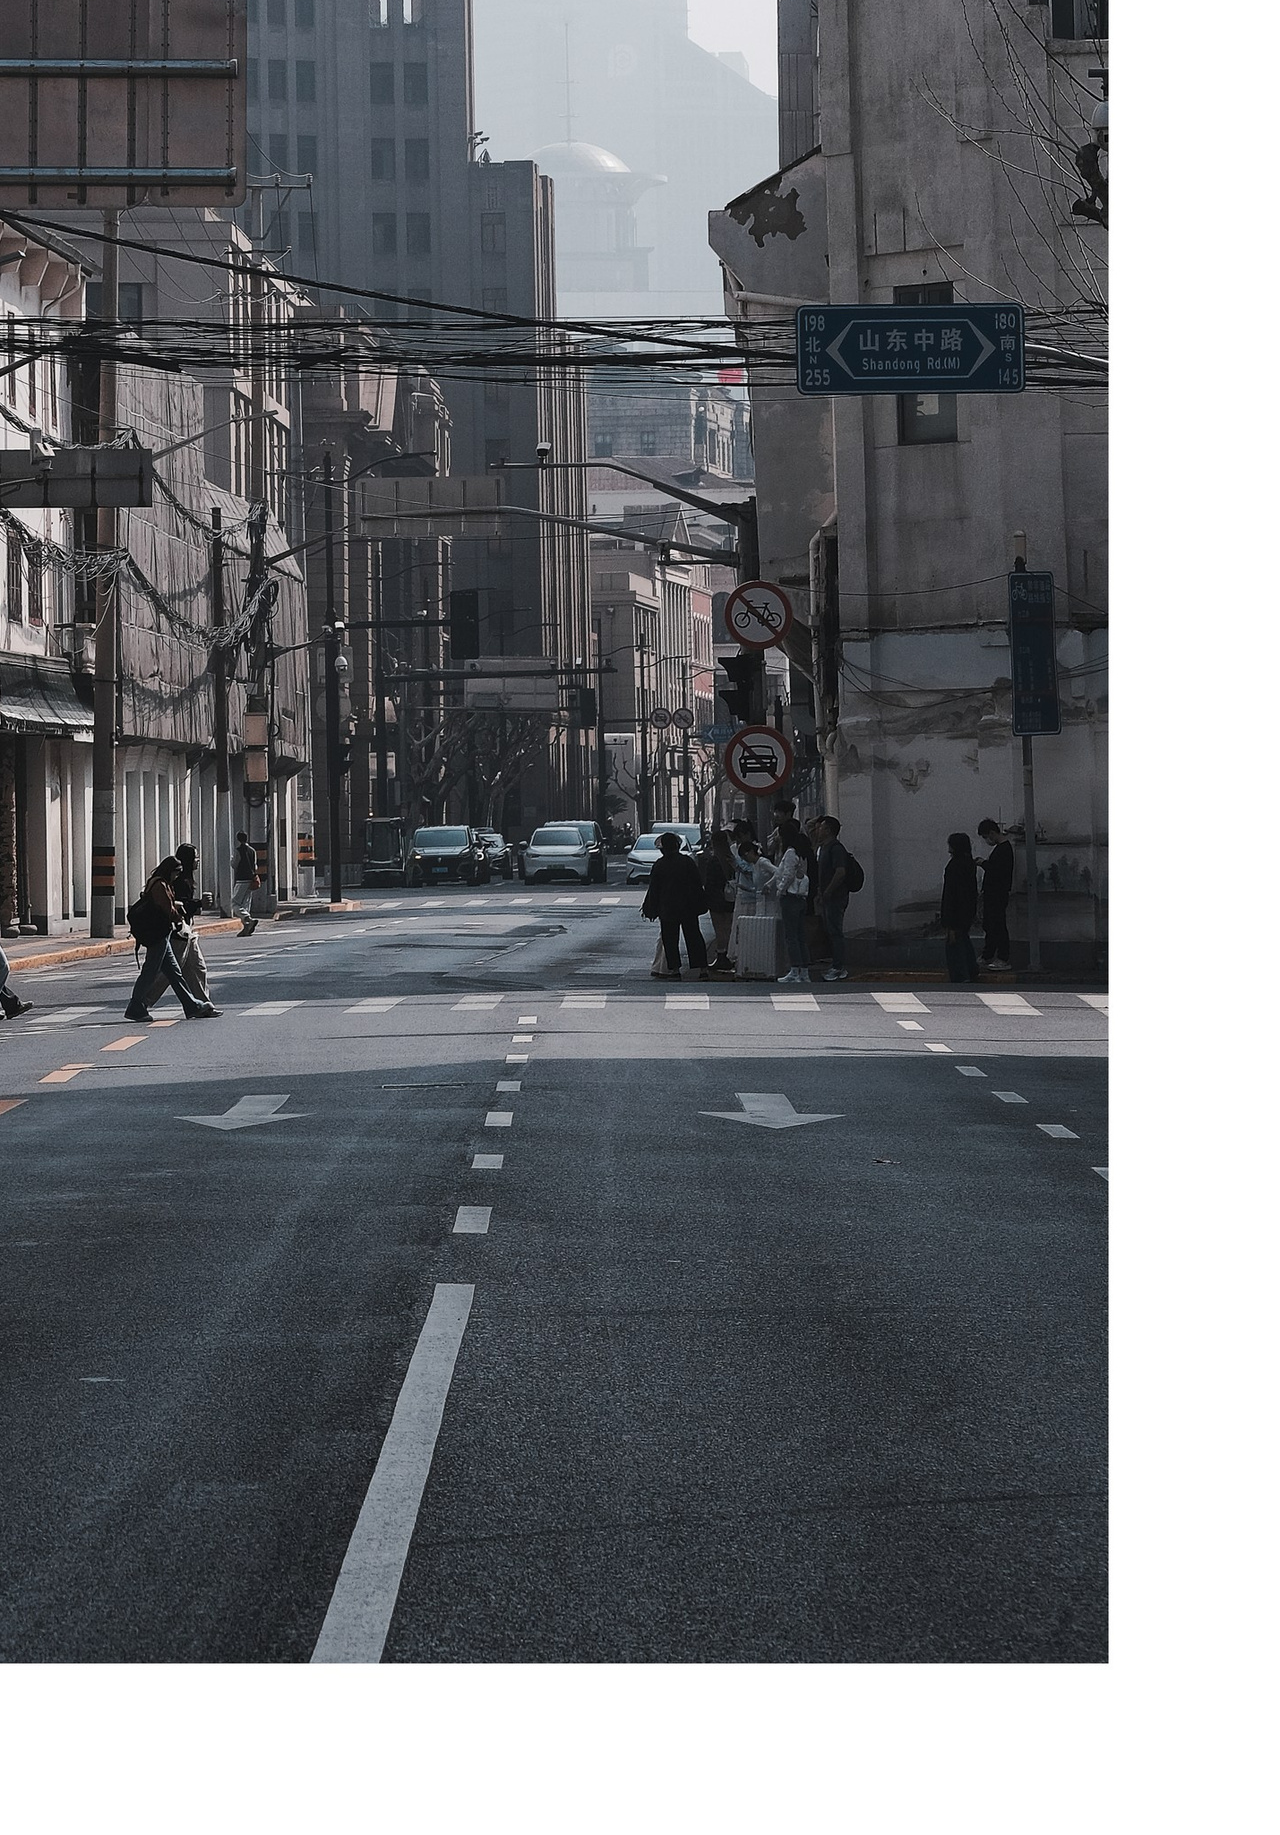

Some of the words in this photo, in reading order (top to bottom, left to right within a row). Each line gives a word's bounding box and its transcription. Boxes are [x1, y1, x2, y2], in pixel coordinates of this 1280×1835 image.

[804, 315, 825, 332] 198
[995, 313, 1016, 330] 180
[805, 337, 821, 353] 北
[859, 328, 964, 352] 山东中路
[1000, 334, 1016, 351] 南
[809, 356, 818, 365] N
[862, 357, 921, 373] Shandong
[927, 357, 961, 370] Rd.(M)
[1005, 353, 1012, 362] S
[805, 369, 831, 386] 255
[998, 368, 1019, 385] 145
